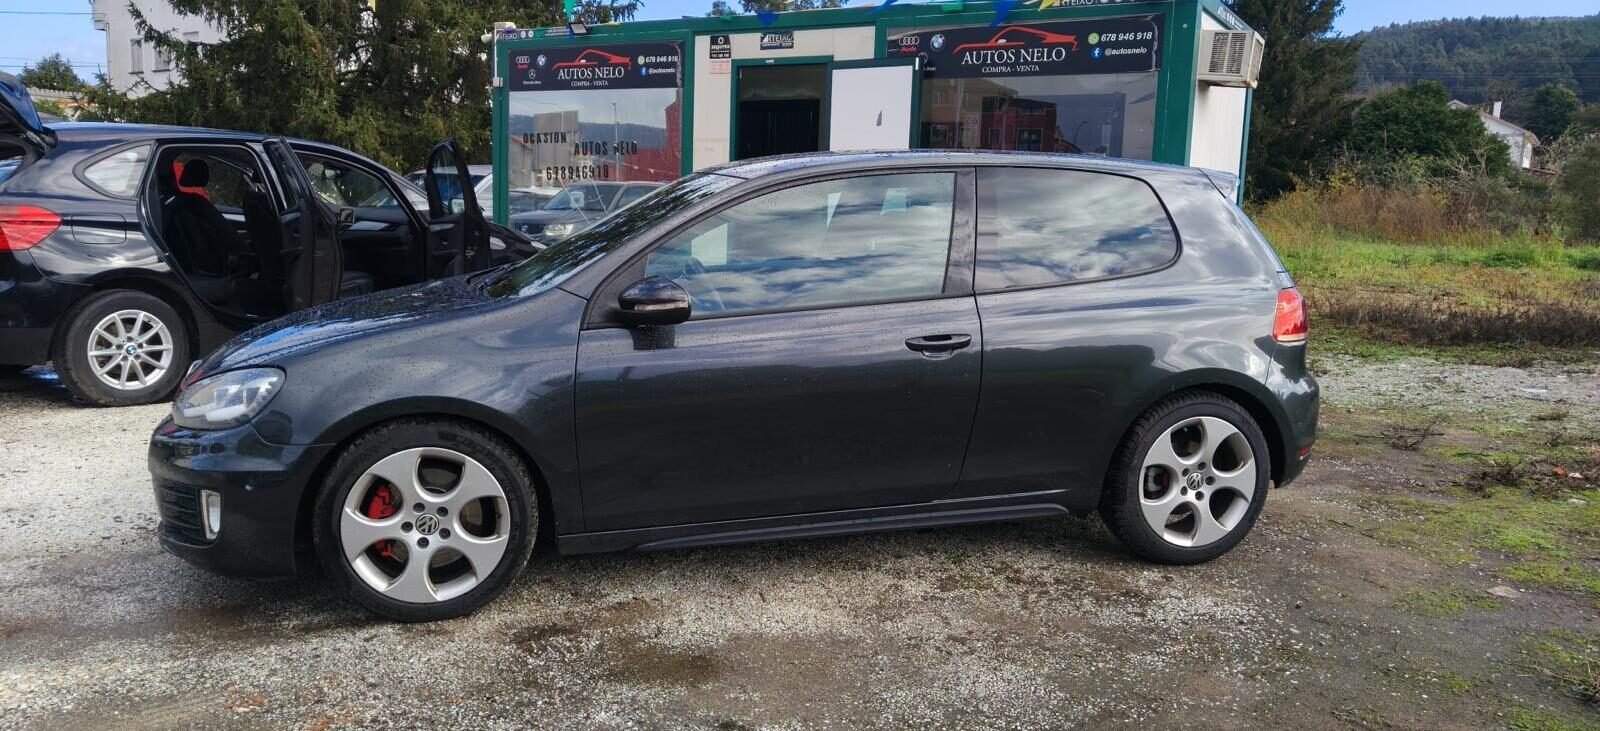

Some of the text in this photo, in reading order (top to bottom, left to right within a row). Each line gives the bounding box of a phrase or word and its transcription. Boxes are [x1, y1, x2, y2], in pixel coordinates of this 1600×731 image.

[1101, 32, 1153, 42] 678 946 918
[961, 47, 1066, 65] AUTOS NELO
[1104, 47, 1147, 56] @autosnelo
[557, 66, 625, 80] AUTOS NELO
[981, 65, 1011, 73] COMPRA
[523, 132, 567, 144] OCASION
[574, 140, 638, 156] AUTOS NELO
[546, 164, 609, 180] 678946918
